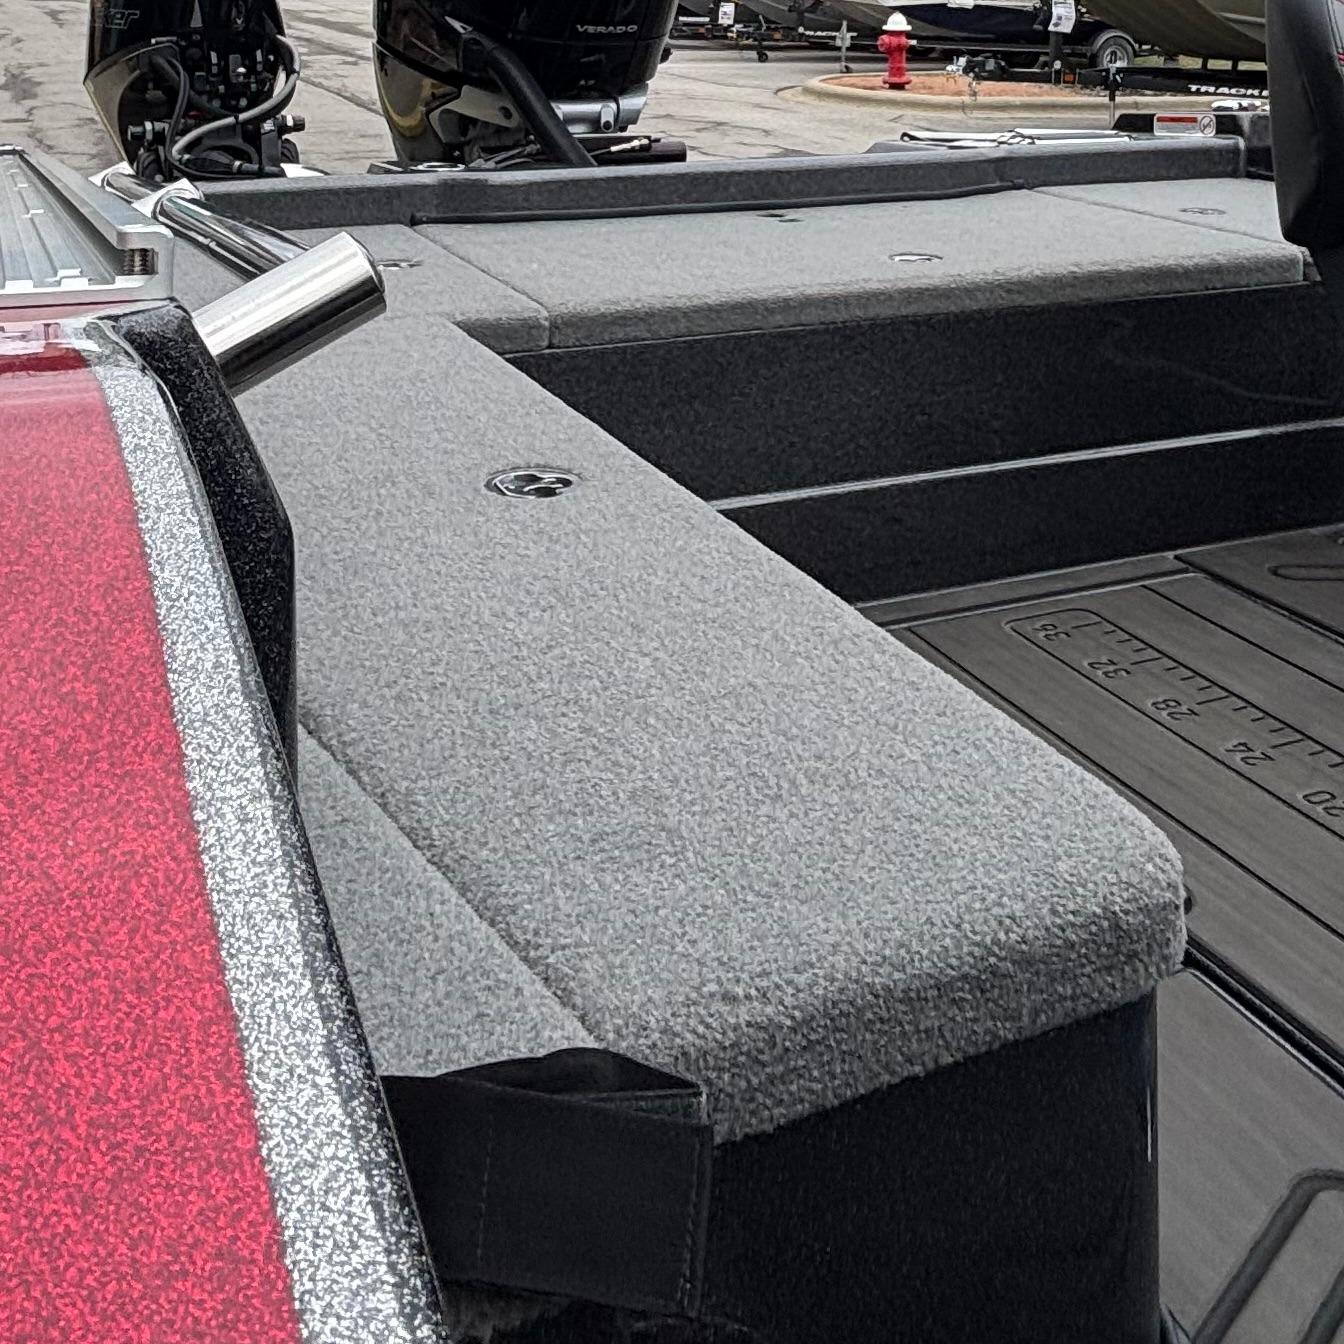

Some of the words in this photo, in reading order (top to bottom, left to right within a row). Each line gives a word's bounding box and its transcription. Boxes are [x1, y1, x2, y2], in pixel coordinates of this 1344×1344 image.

[576, 24, 638, 34] VERADO
[1087, 657, 1132, 679] 32
[1151, 698, 1200, 722] 28
[1225, 741, 1276, 767] 24
